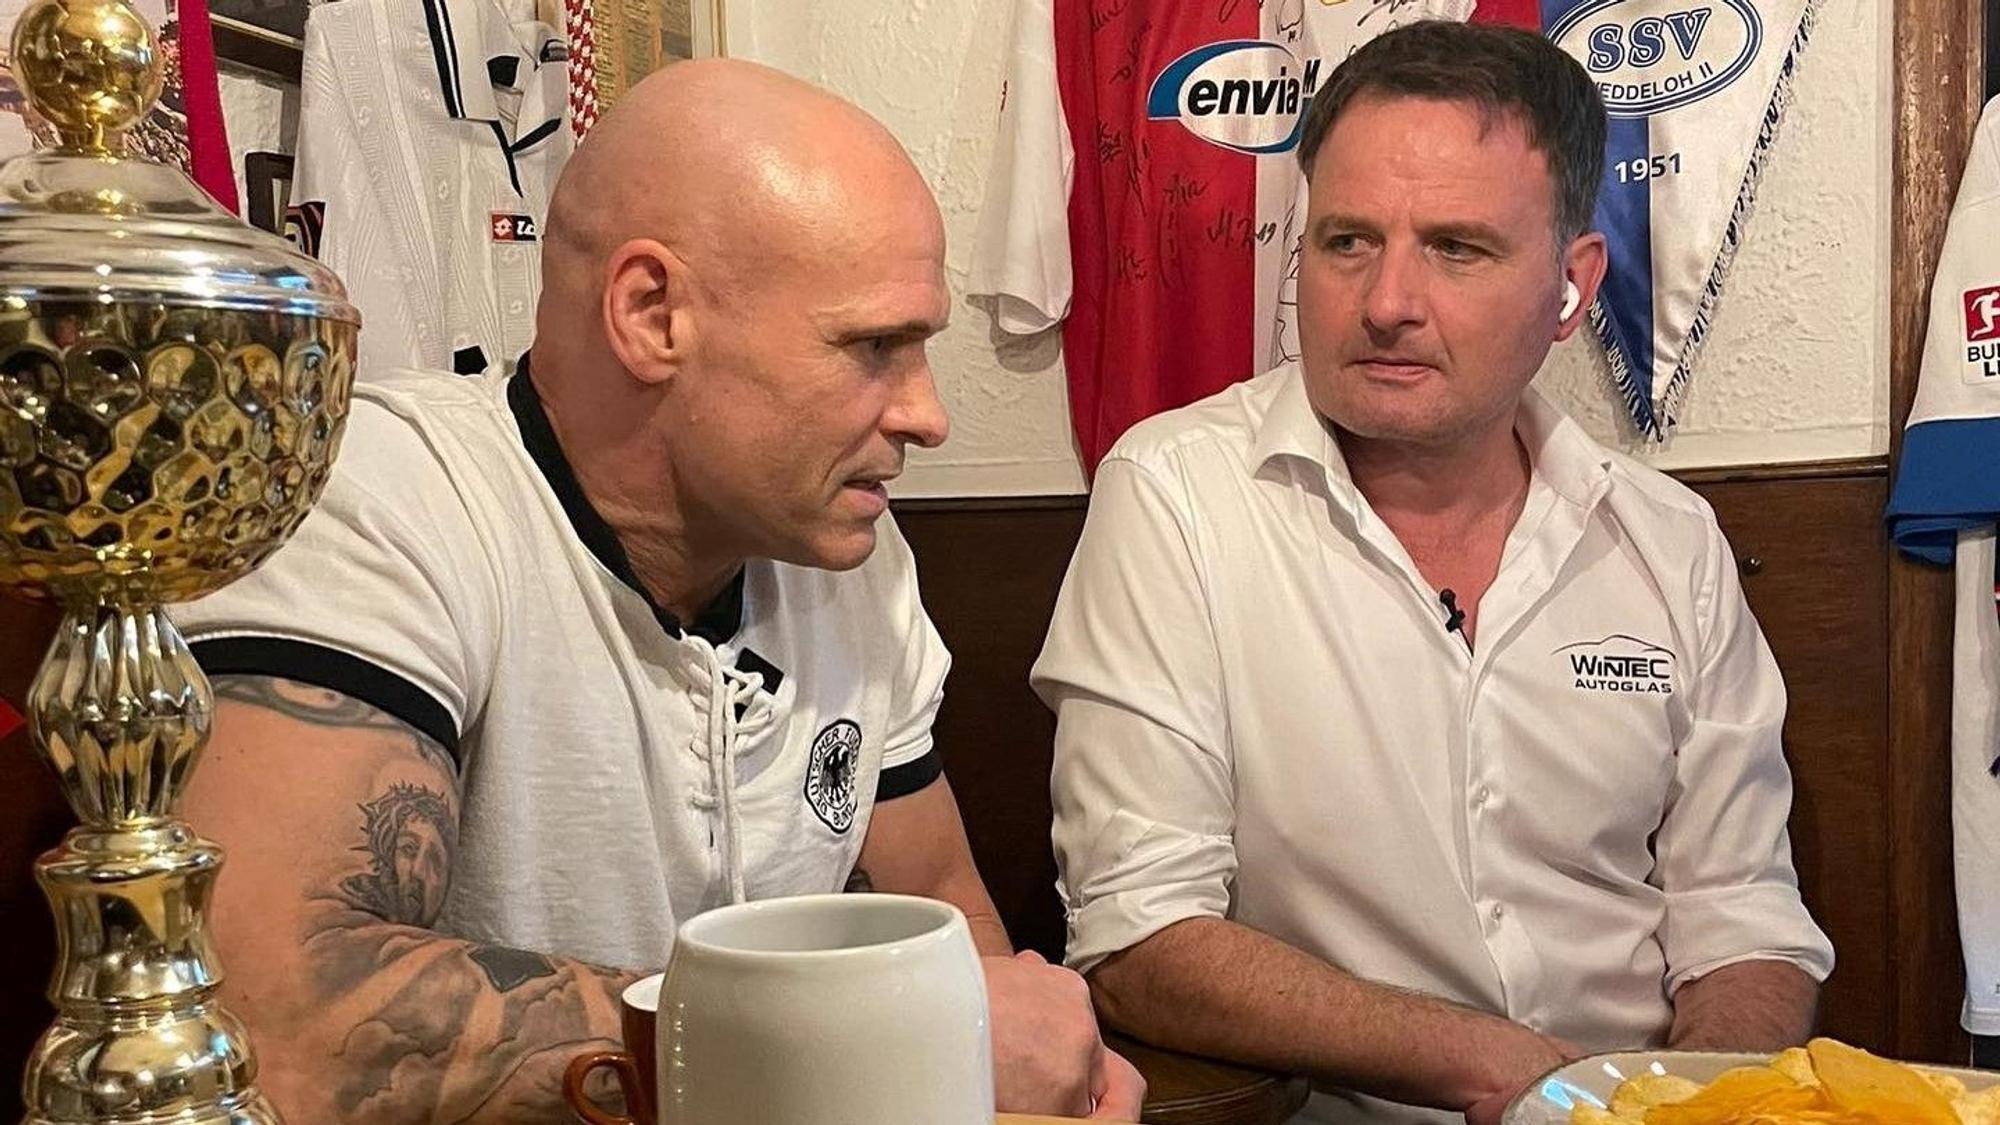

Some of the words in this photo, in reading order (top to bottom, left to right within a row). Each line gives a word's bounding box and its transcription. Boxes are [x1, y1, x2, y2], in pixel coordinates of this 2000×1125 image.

[1587, 7, 1712, 73] SSV
[1594, 71, 1693, 100] EDDELOH
[1615, 153, 1682, 183] 1951
[1967, 343, 2000, 362] BU
[1575, 678, 1672, 694] AUTOGLAS
